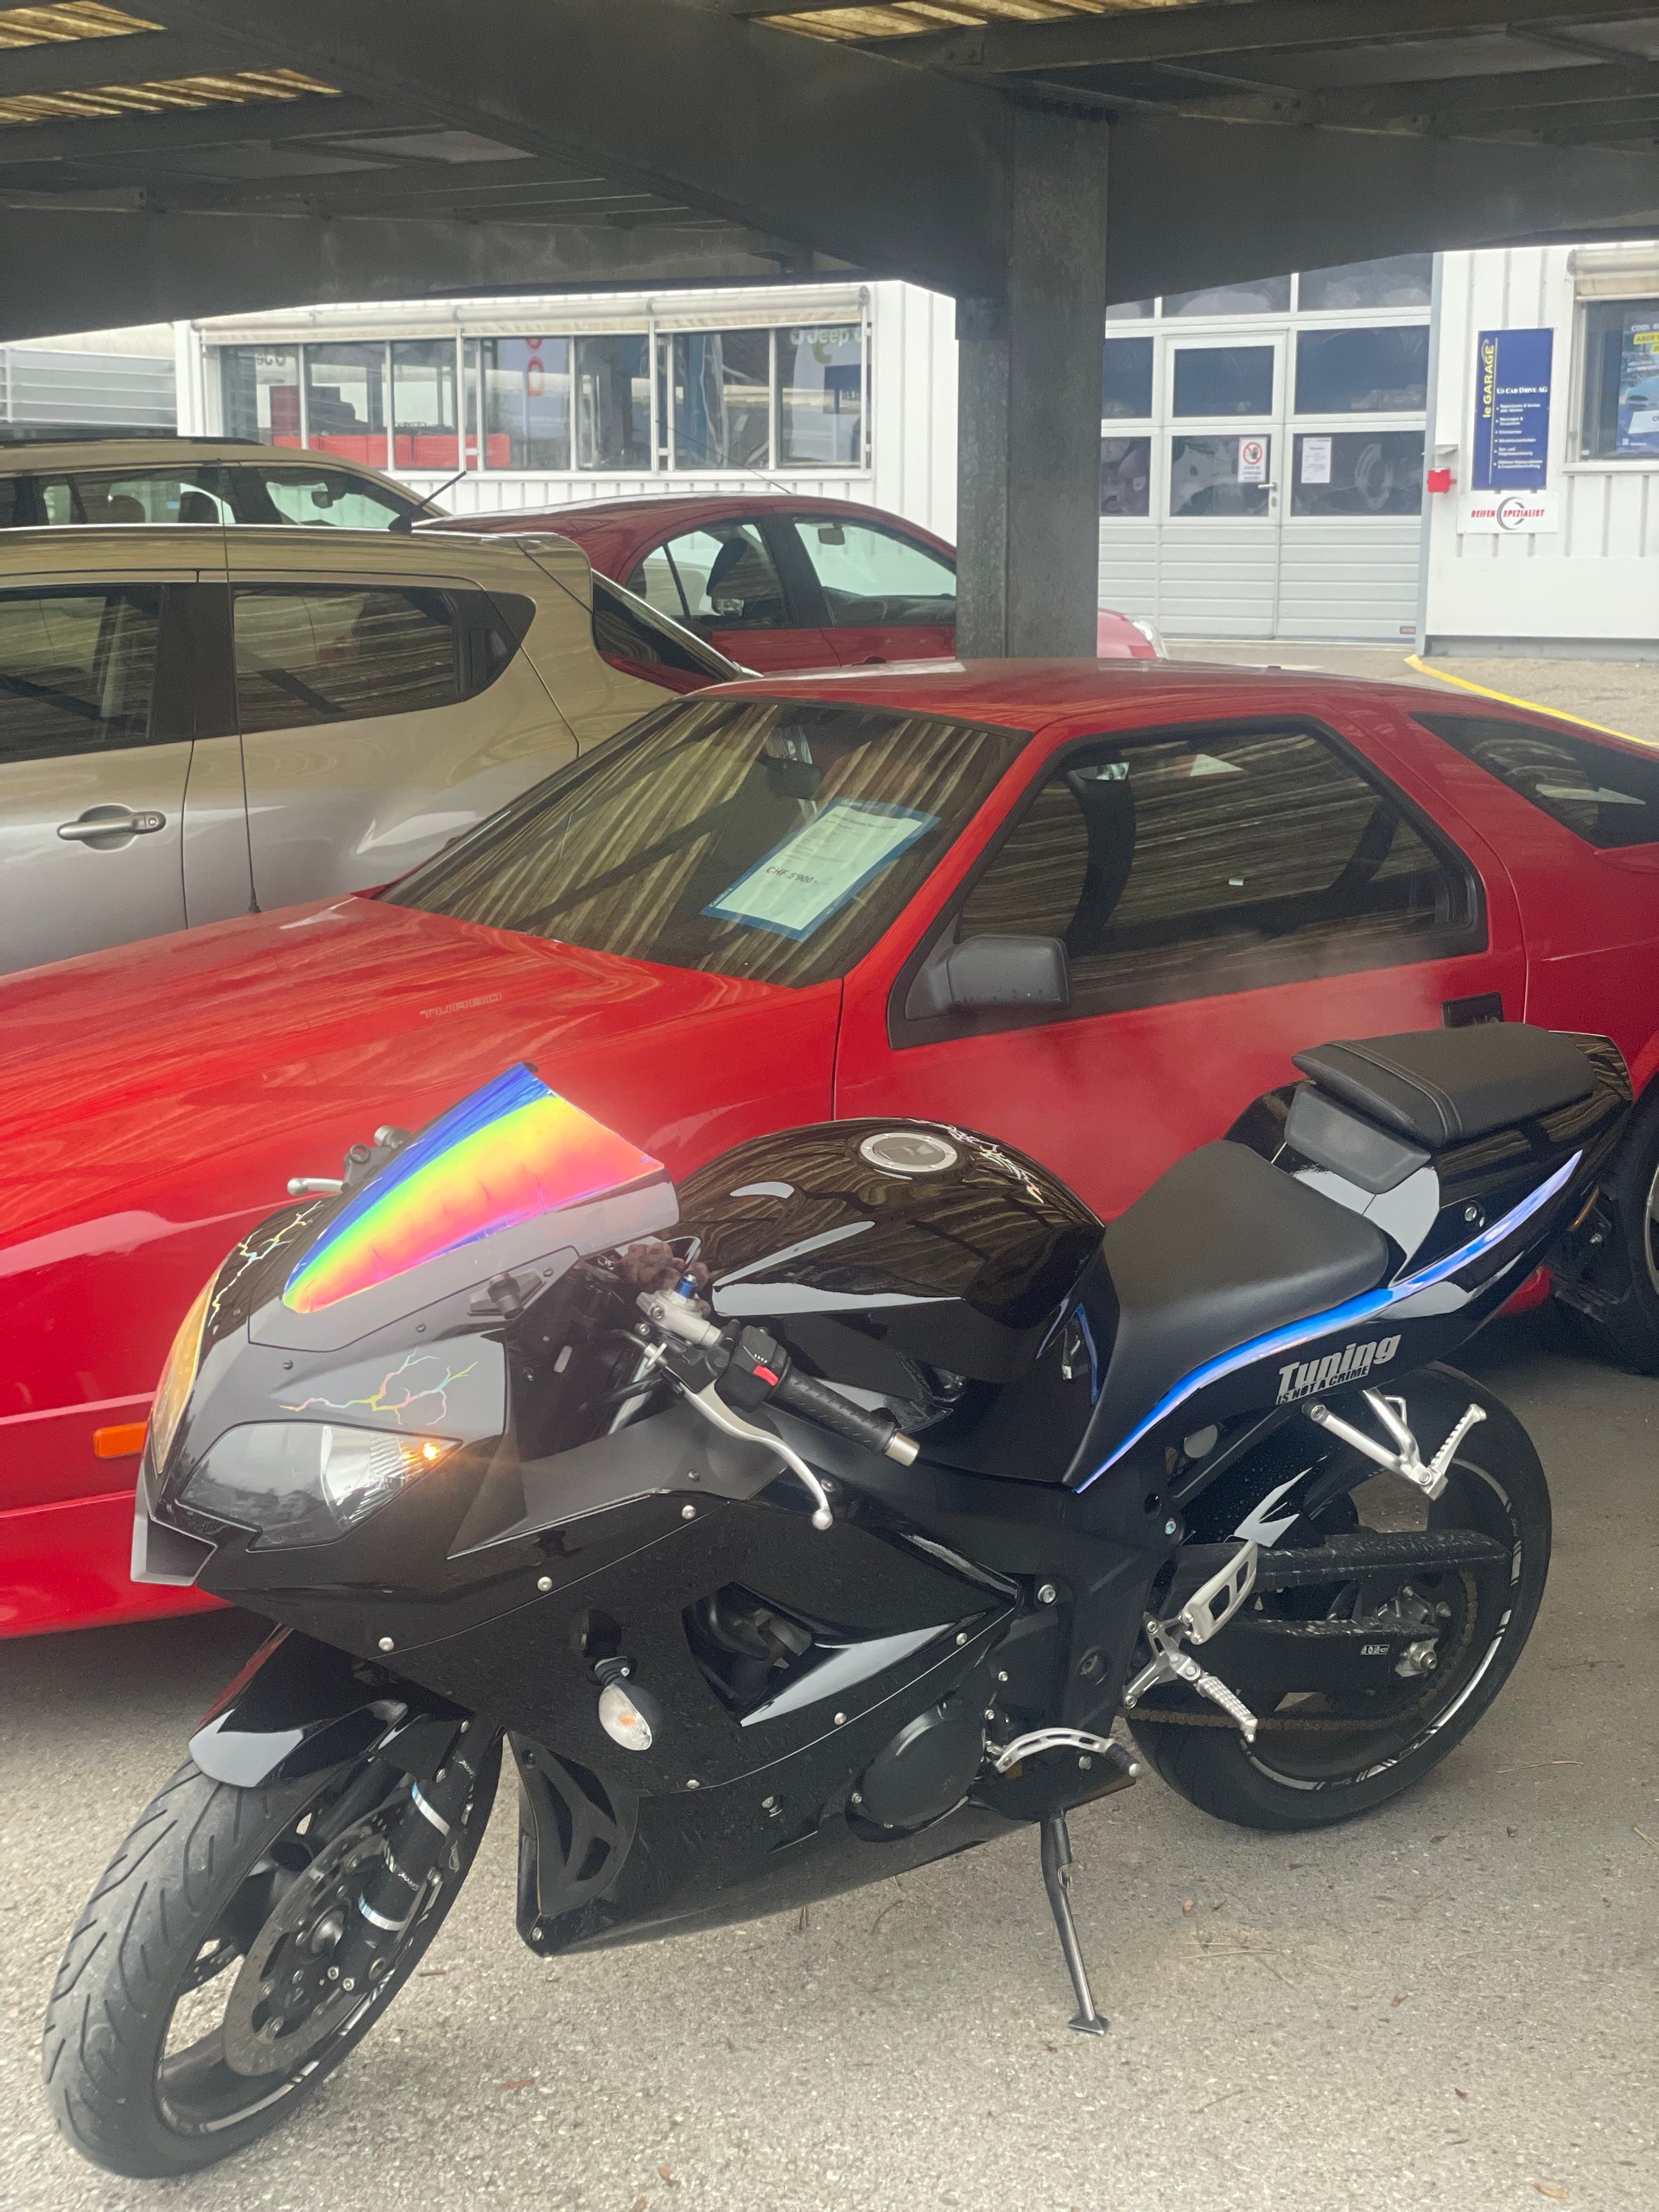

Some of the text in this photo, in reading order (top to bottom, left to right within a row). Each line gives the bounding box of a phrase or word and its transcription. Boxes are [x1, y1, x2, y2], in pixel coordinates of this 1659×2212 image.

[807, 328, 850, 347] Jeep
[1483, 346, 1494, 418] le GARAGE
[1503, 509, 1545, 518] SPEZIALIST
[766, 866, 789, 877] CHF
[420, 993, 501, 1018] TURBO
[1278, 1334, 1402, 1395] Tuning
[1277, 1365, 1370, 1405] IS NOT A CRIME
